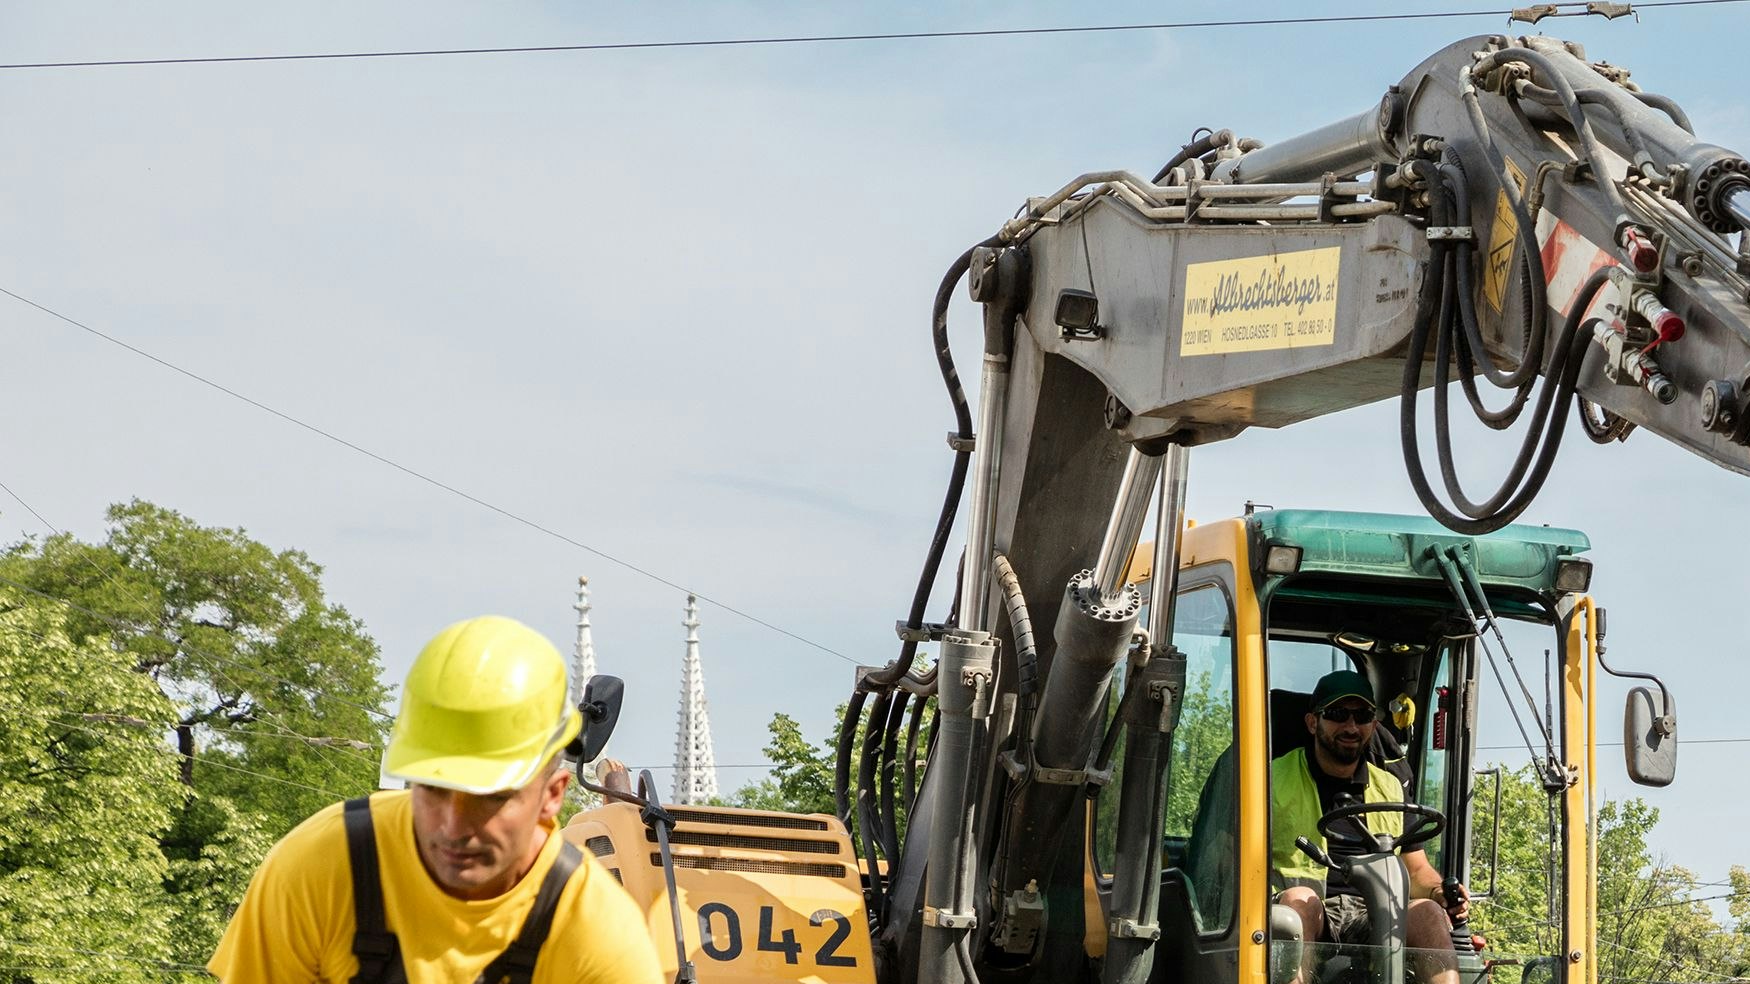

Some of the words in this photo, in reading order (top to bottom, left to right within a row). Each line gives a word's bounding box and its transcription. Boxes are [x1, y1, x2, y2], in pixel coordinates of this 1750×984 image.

[1187, 265, 1335, 318] www.Albrechtsberger.at
[1196, 329, 1212, 344] WIEN
[1270, 323, 1278, 338] 10
[697, 902, 857, 968] 042
